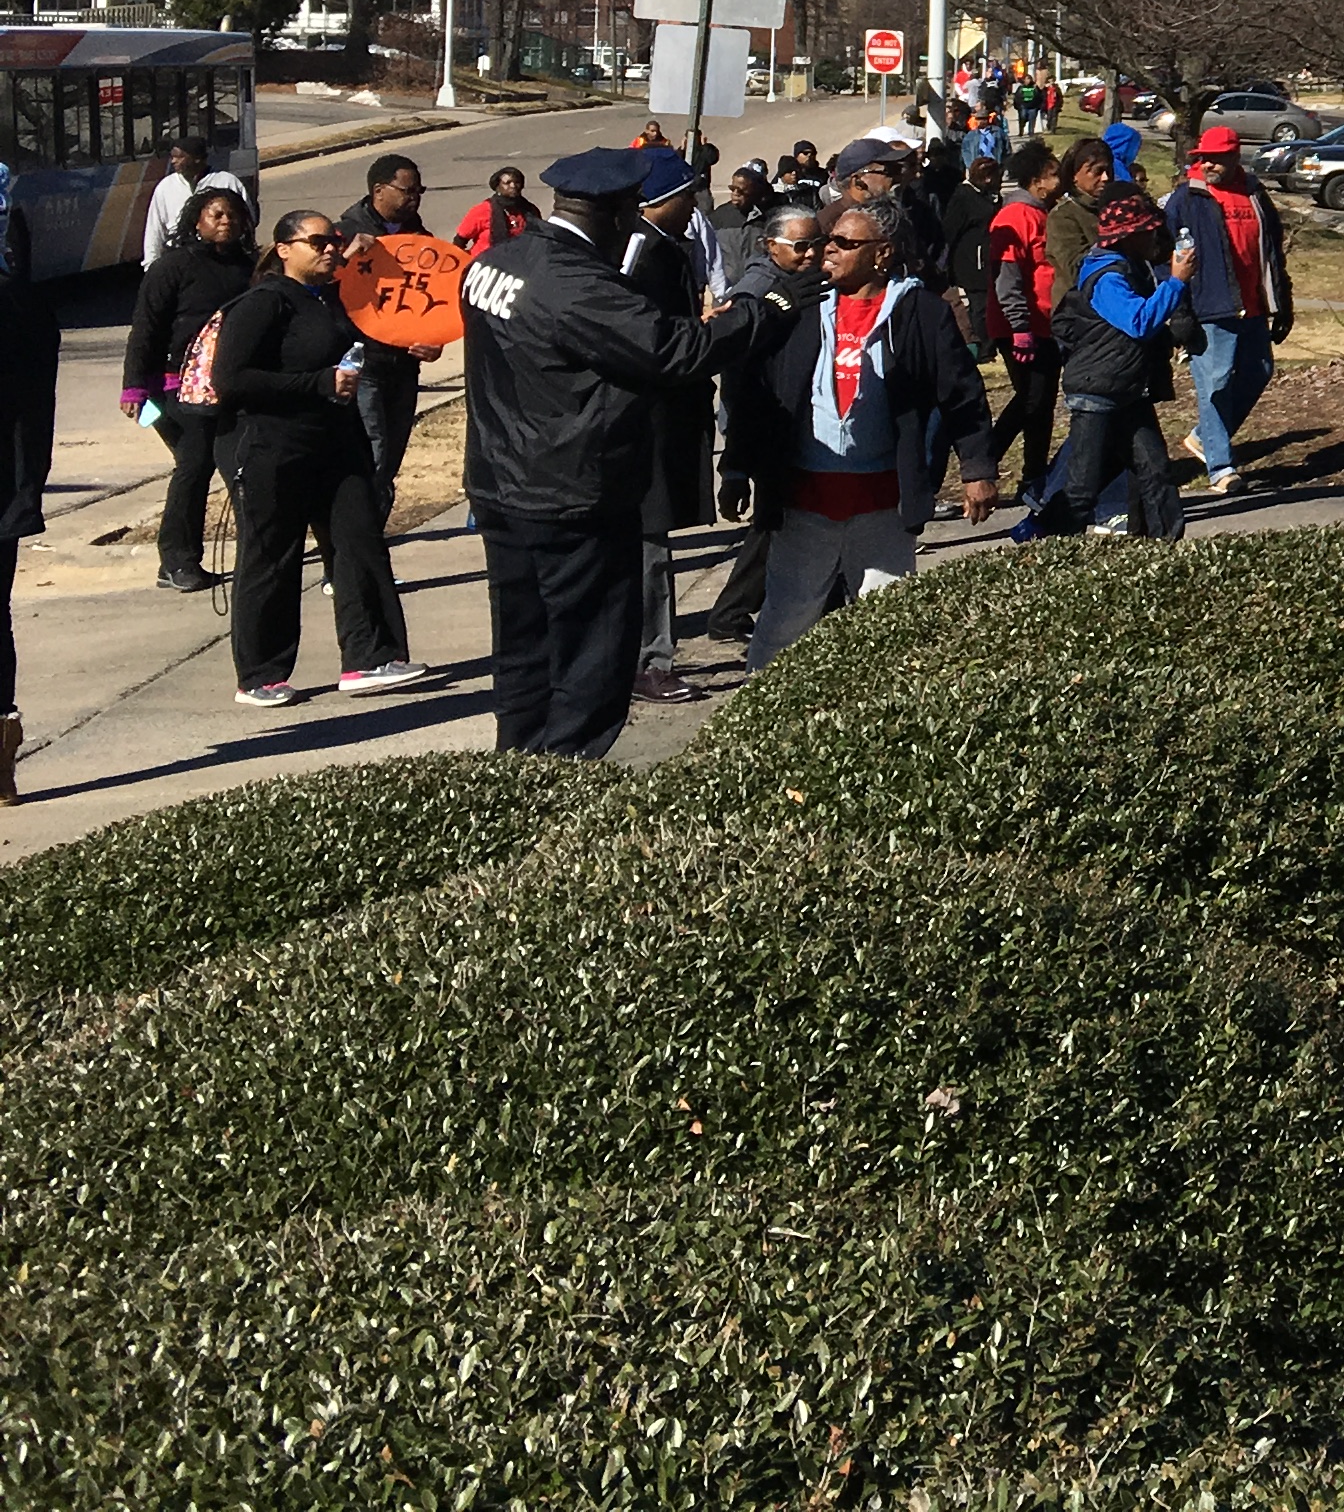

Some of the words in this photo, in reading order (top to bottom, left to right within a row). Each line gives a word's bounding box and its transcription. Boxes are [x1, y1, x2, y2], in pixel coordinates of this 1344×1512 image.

[871, 38, 882, 47] DO
[394, 242, 461, 274] GOD
[400, 270, 431, 291] IS
[461, 261, 525, 320] POLICE
[376, 286, 449, 318] FLY
